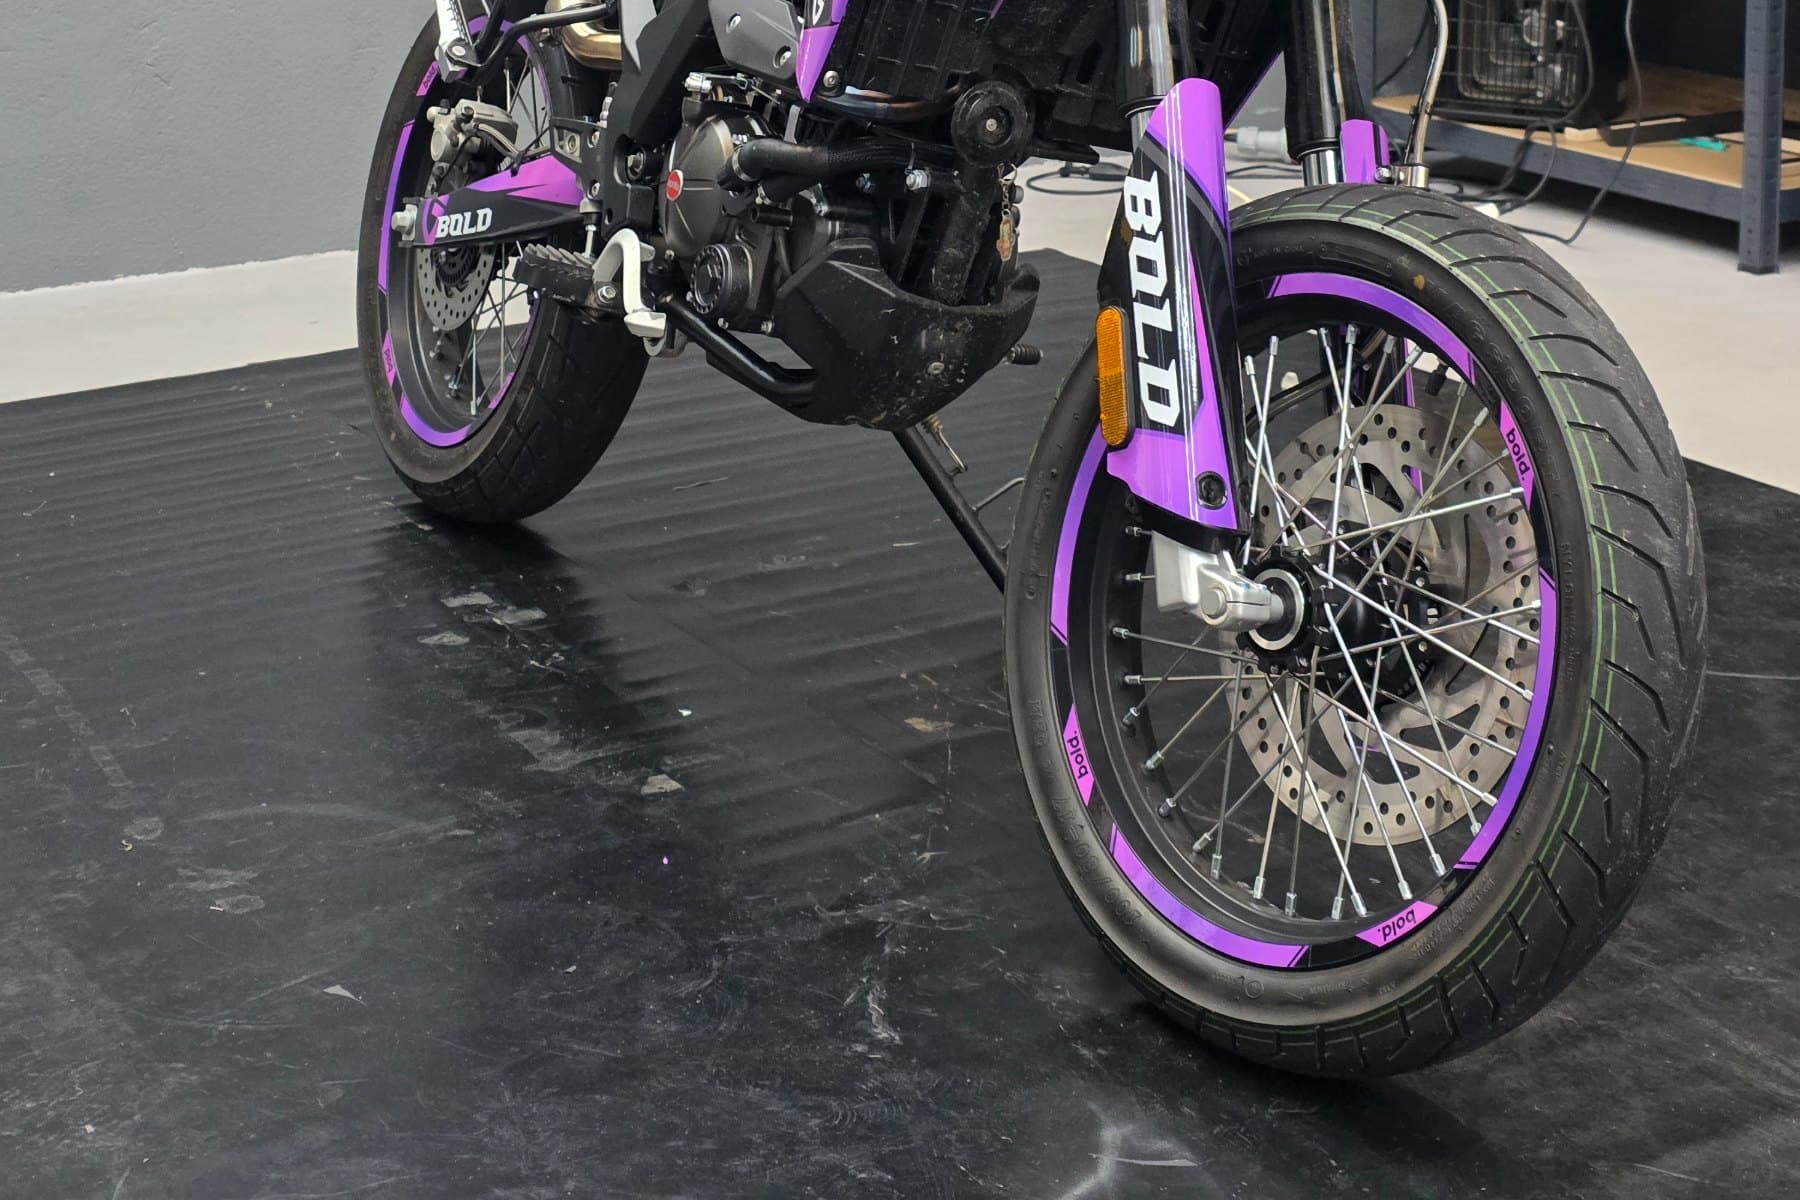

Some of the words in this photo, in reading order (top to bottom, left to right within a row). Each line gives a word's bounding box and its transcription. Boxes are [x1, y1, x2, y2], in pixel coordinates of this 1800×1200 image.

[435, 207, 493, 239] BOLD
[1123, 170, 1181, 428] BOLD
[1506, 427, 1530, 481] bold.
[1066, 730, 1089, 780] bold.
[1377, 908, 1417, 942] bold.
